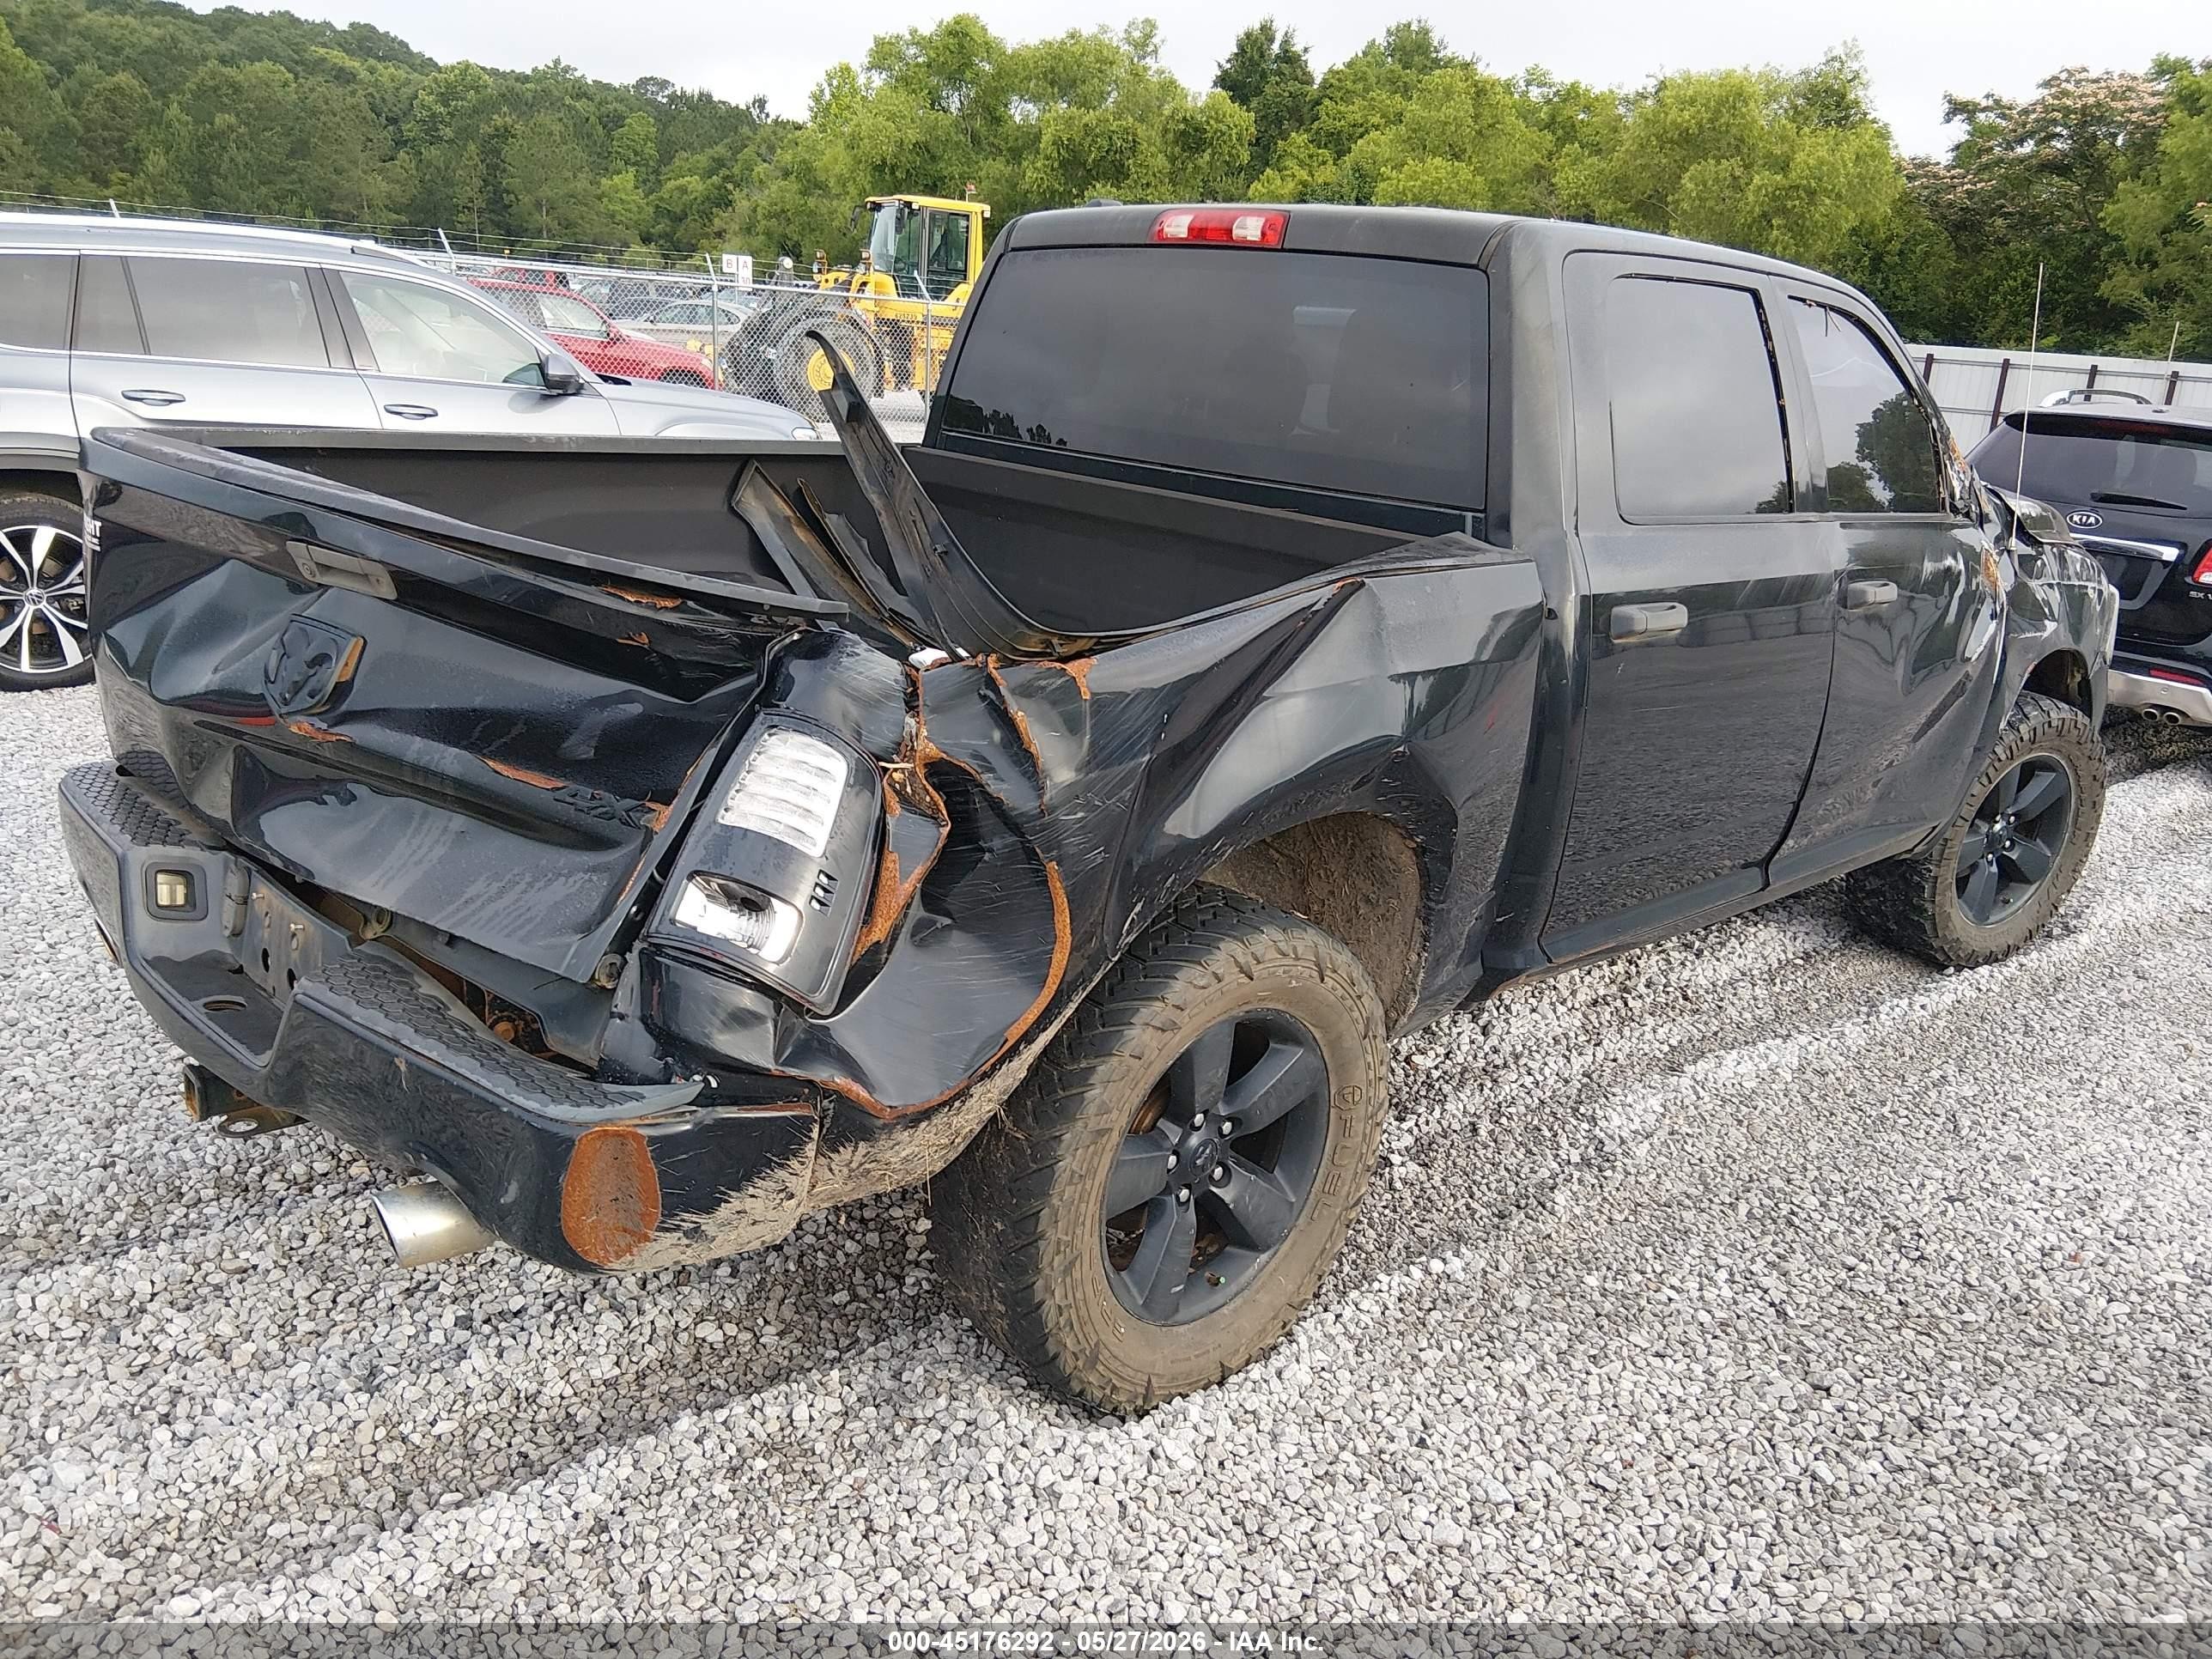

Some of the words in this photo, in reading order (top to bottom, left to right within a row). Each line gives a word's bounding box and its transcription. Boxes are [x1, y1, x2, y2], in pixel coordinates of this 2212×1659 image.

[726, 258, 733, 269] B
[742, 260, 749, 271] A
[2071, 515, 2096, 525] KIA
[2189, 591, 2205, 599] SX
[1310, 1115, 1354, 1222] FUEL
